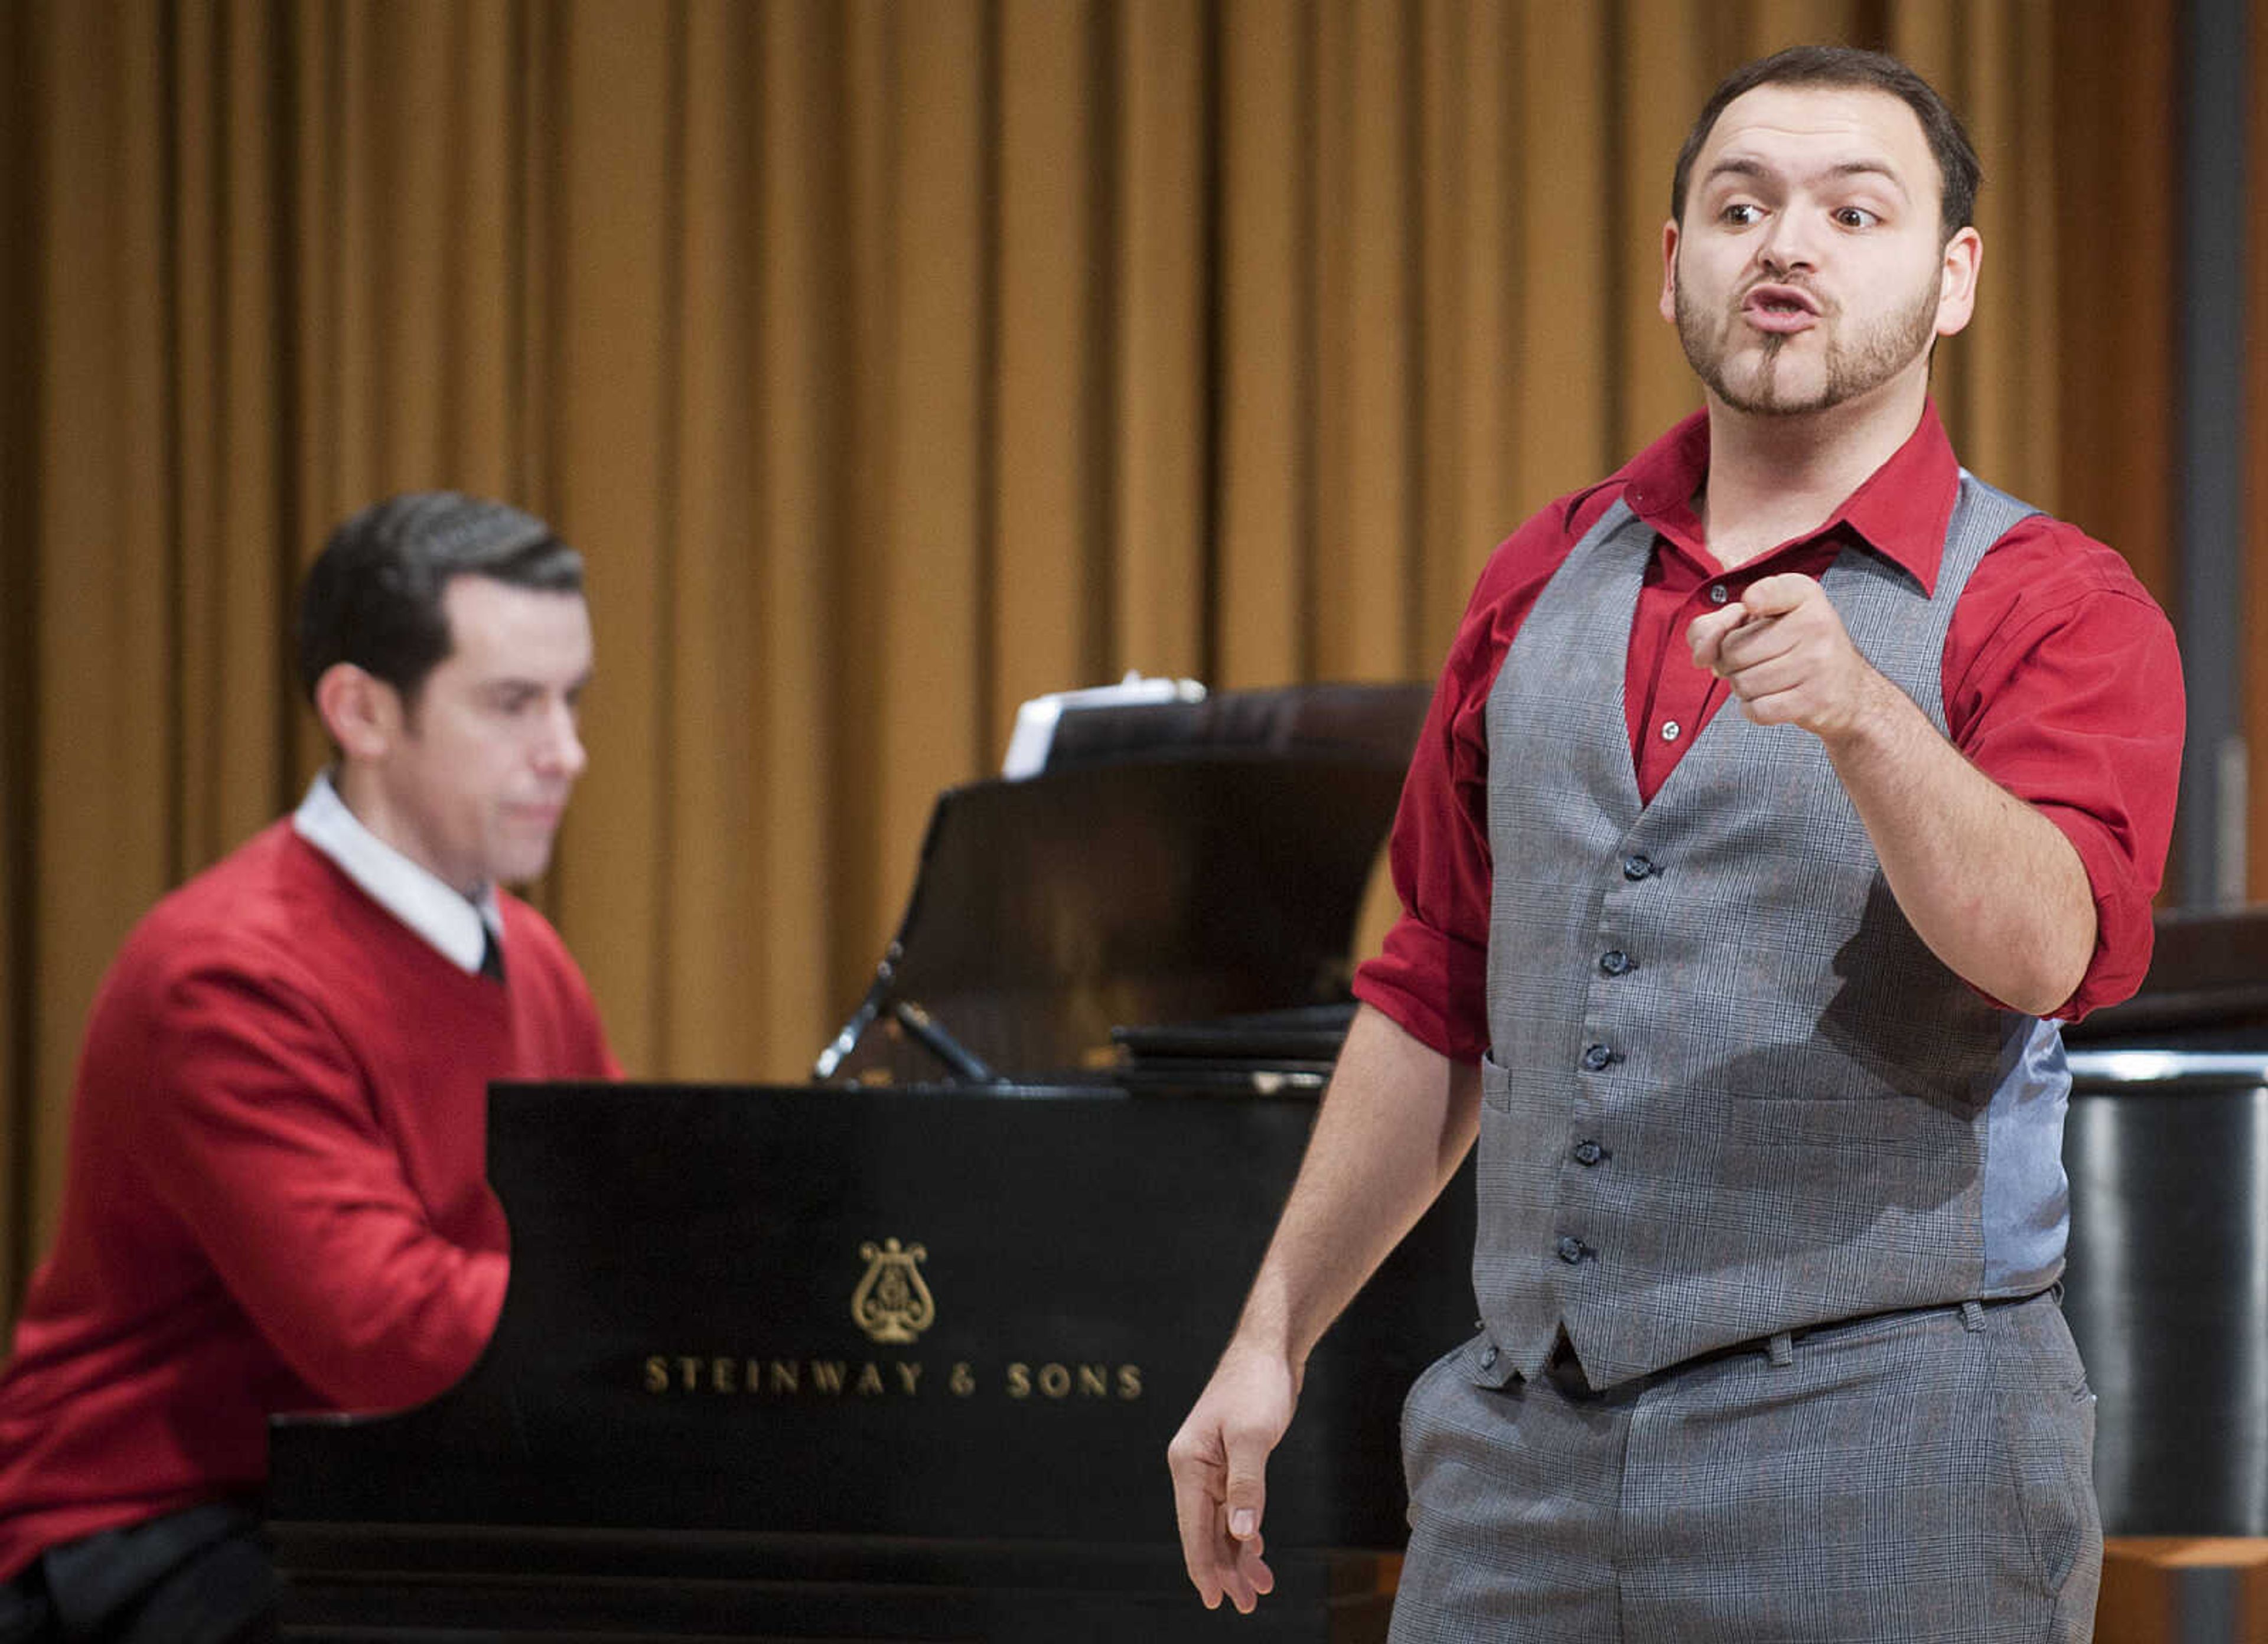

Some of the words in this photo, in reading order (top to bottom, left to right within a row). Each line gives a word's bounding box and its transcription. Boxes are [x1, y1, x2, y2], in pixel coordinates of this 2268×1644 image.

[646, 1355, 923, 1394] STEINWAY
[950, 1362, 976, 1396] &
[1008, 1362, 1142, 1399] SONS
